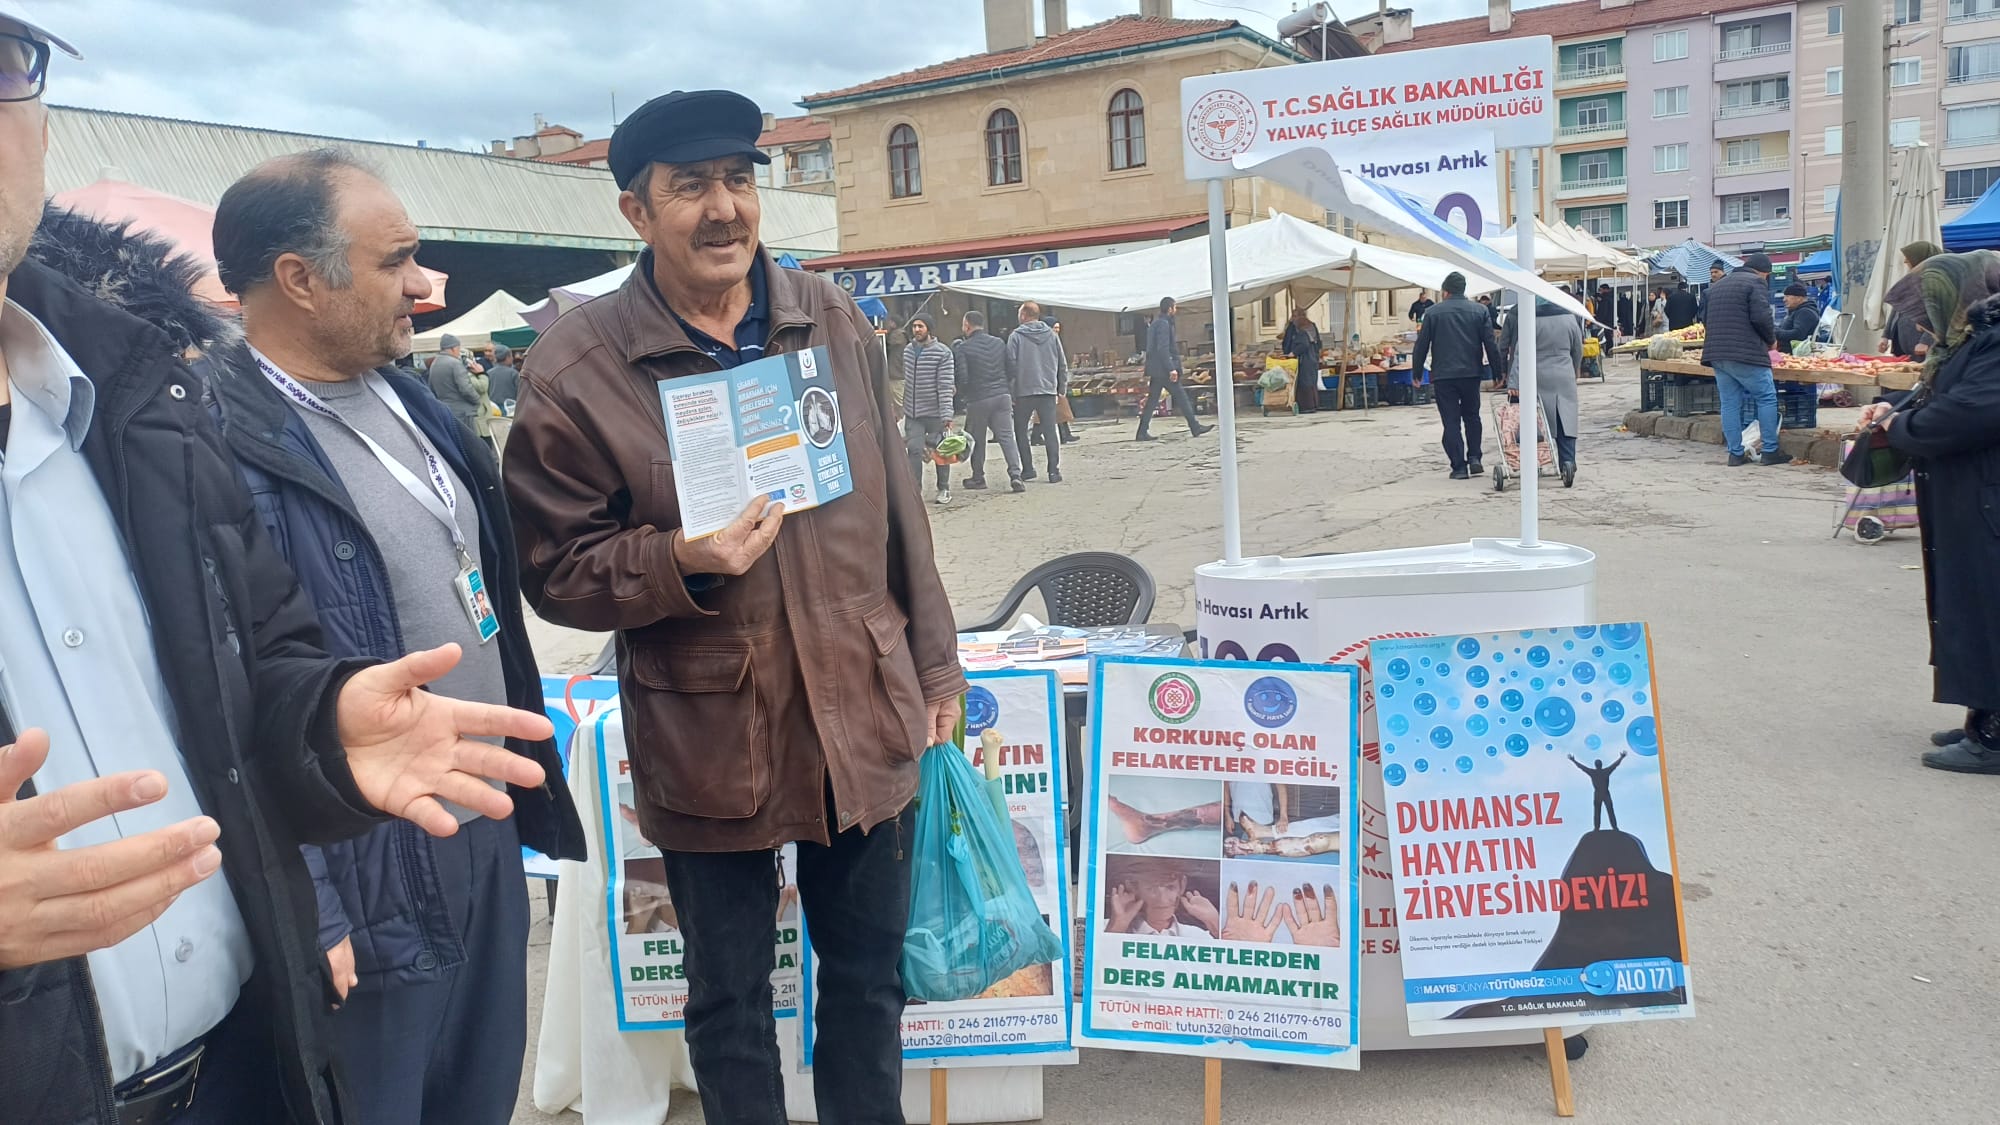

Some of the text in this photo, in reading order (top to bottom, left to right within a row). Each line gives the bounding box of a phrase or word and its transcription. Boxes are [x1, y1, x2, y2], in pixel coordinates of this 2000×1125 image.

[1404, 66, 1544, 104] BAKANLIĞI
[1267, 123, 1328, 142] YALVAÇ
[1331, 119, 1367, 138] İLÇE
[1371, 110, 1432, 131] SAĞLIK
[1436, 96, 1544, 123] MÜDÜRLÜĞÜ
[1437, 150, 1488, 171] Artık
[1204, 598, 1252, 619] Havası
[1259, 602, 1309, 620] Artık
[1134, 727, 1317, 753] KORKUNÇ OLAN
[1112, 751, 1338, 782] FELAKETLER DEĞİL;
[1000, 772, 1048, 795] IN!
[1396, 792, 1563, 834] DUMANSIZ
[1401, 836, 1537, 877] HAYATIN
[1403, 867, 1649, 921] ZİRVESİNDEYİZ!
[644, 939, 686, 956] FEL
[1122, 941, 1321, 971] FELAKETLERDEN
[630, 964, 686, 981] DERS
[1103, 967, 1339, 1000] DERS ALMAMAKTIR
[1616, 967, 1674, 992] ALO 171
[631, 994, 668, 1007] TÜTÜN
[781, 983, 796, 994] 211
[1501, 999, 1586, 1012] T.C. SAĞLIK BAKANLIĞI
[662, 1010, 685, 1018] e-m
[907, 1020, 944, 1031] HATTI:
[948, 1018, 955, 1029] 0
[958, 1018, 980, 1029] 246
[983, 1013, 1058, 1029] 2116779-6780
[1099, 1001, 1140, 1014] TÜTÜN
[1144, 1002, 1183, 1017] İHBAR
[1227, 1009, 1234, 1020] 0
[1238, 1010, 1260, 1022] 246
[1263, 1012, 1342, 1029] 2116779-6780
[902, 1032, 1027, 1047] utun32@hotmail.com
[1131, 1018, 1308, 1041] e-mail: tutun32@hotmail.com
